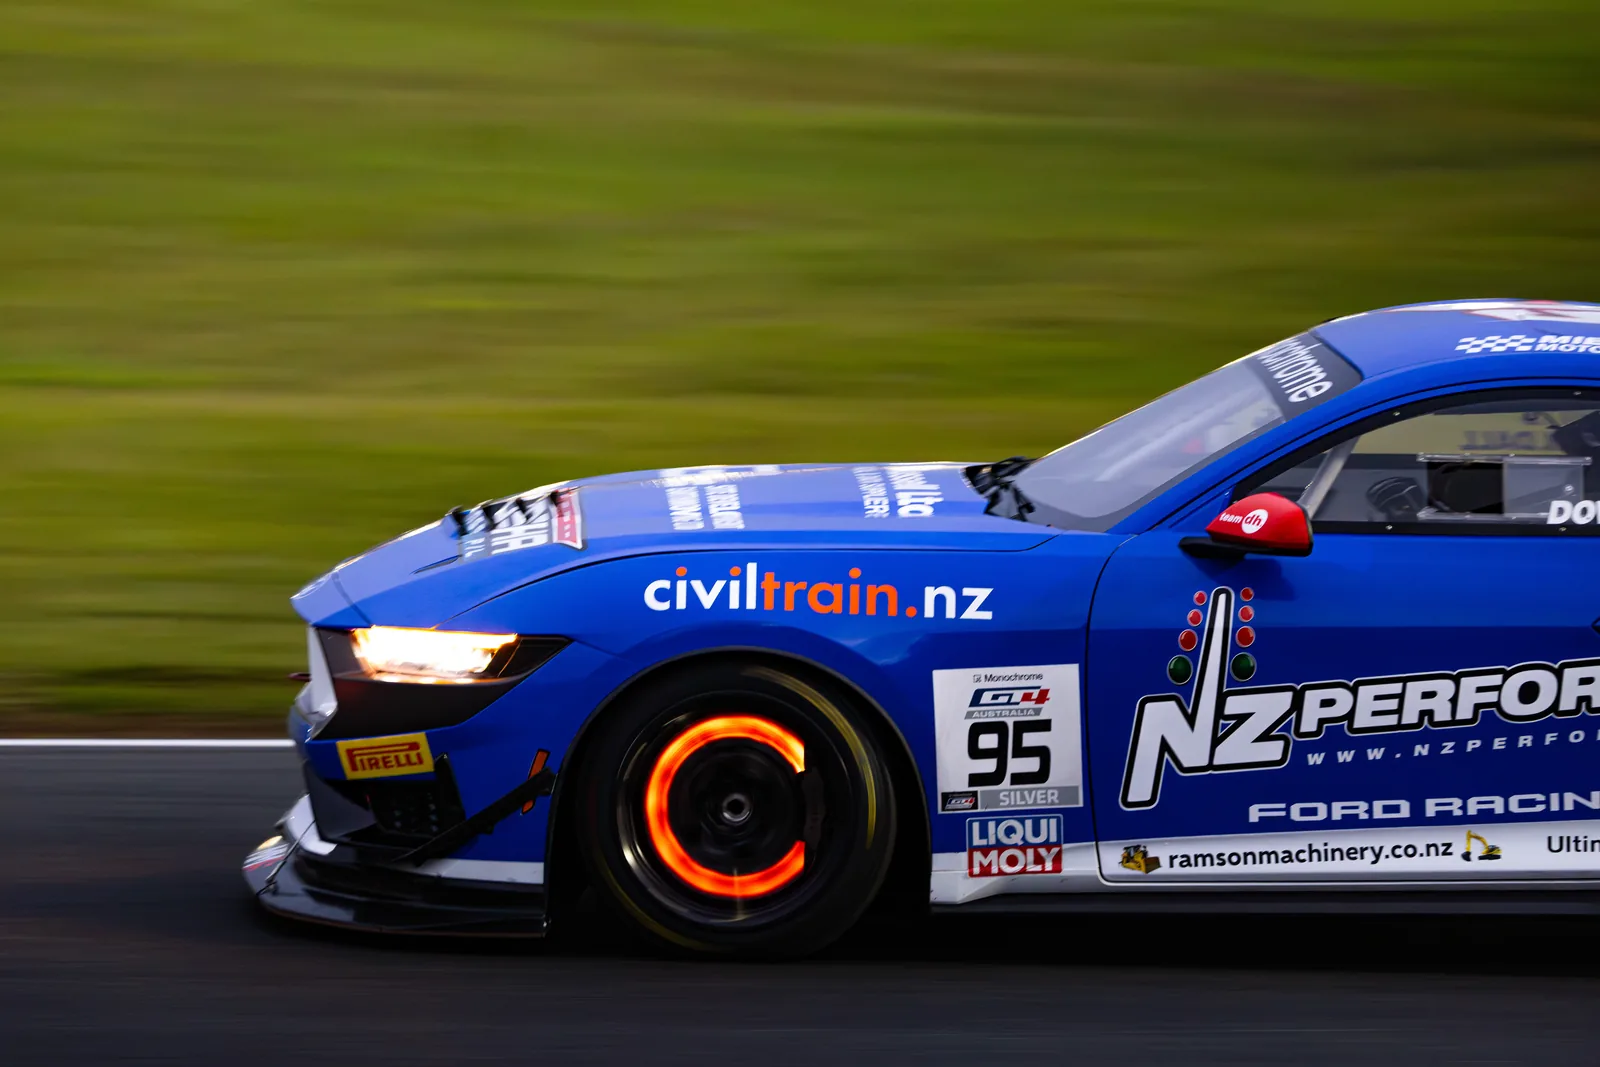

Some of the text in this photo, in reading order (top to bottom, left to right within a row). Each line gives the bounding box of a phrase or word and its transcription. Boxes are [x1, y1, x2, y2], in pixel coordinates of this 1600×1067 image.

[1219, 512, 1262, 526] team dh
[1546, 500, 1600, 525] DO
[644, 562, 993, 621] civiltrain.nz
[984, 672, 1044, 683] Monochrome
[969, 685, 1051, 708] GT4
[972, 709, 1036, 719] AUSTRALIA
[345, 741, 425, 772] PIRELLI
[967, 719, 1052, 787] 95
[1307, 728, 1600, 765] WWW.NZPERFO
[1000, 788, 1059, 807] SILVER
[1248, 788, 1600, 823] FORD RACIN
[972, 817, 1058, 846] LIQUI
[973, 847, 1061, 876] MOLY
[1168, 840, 1454, 870] ramsonmachinery.co.nz
